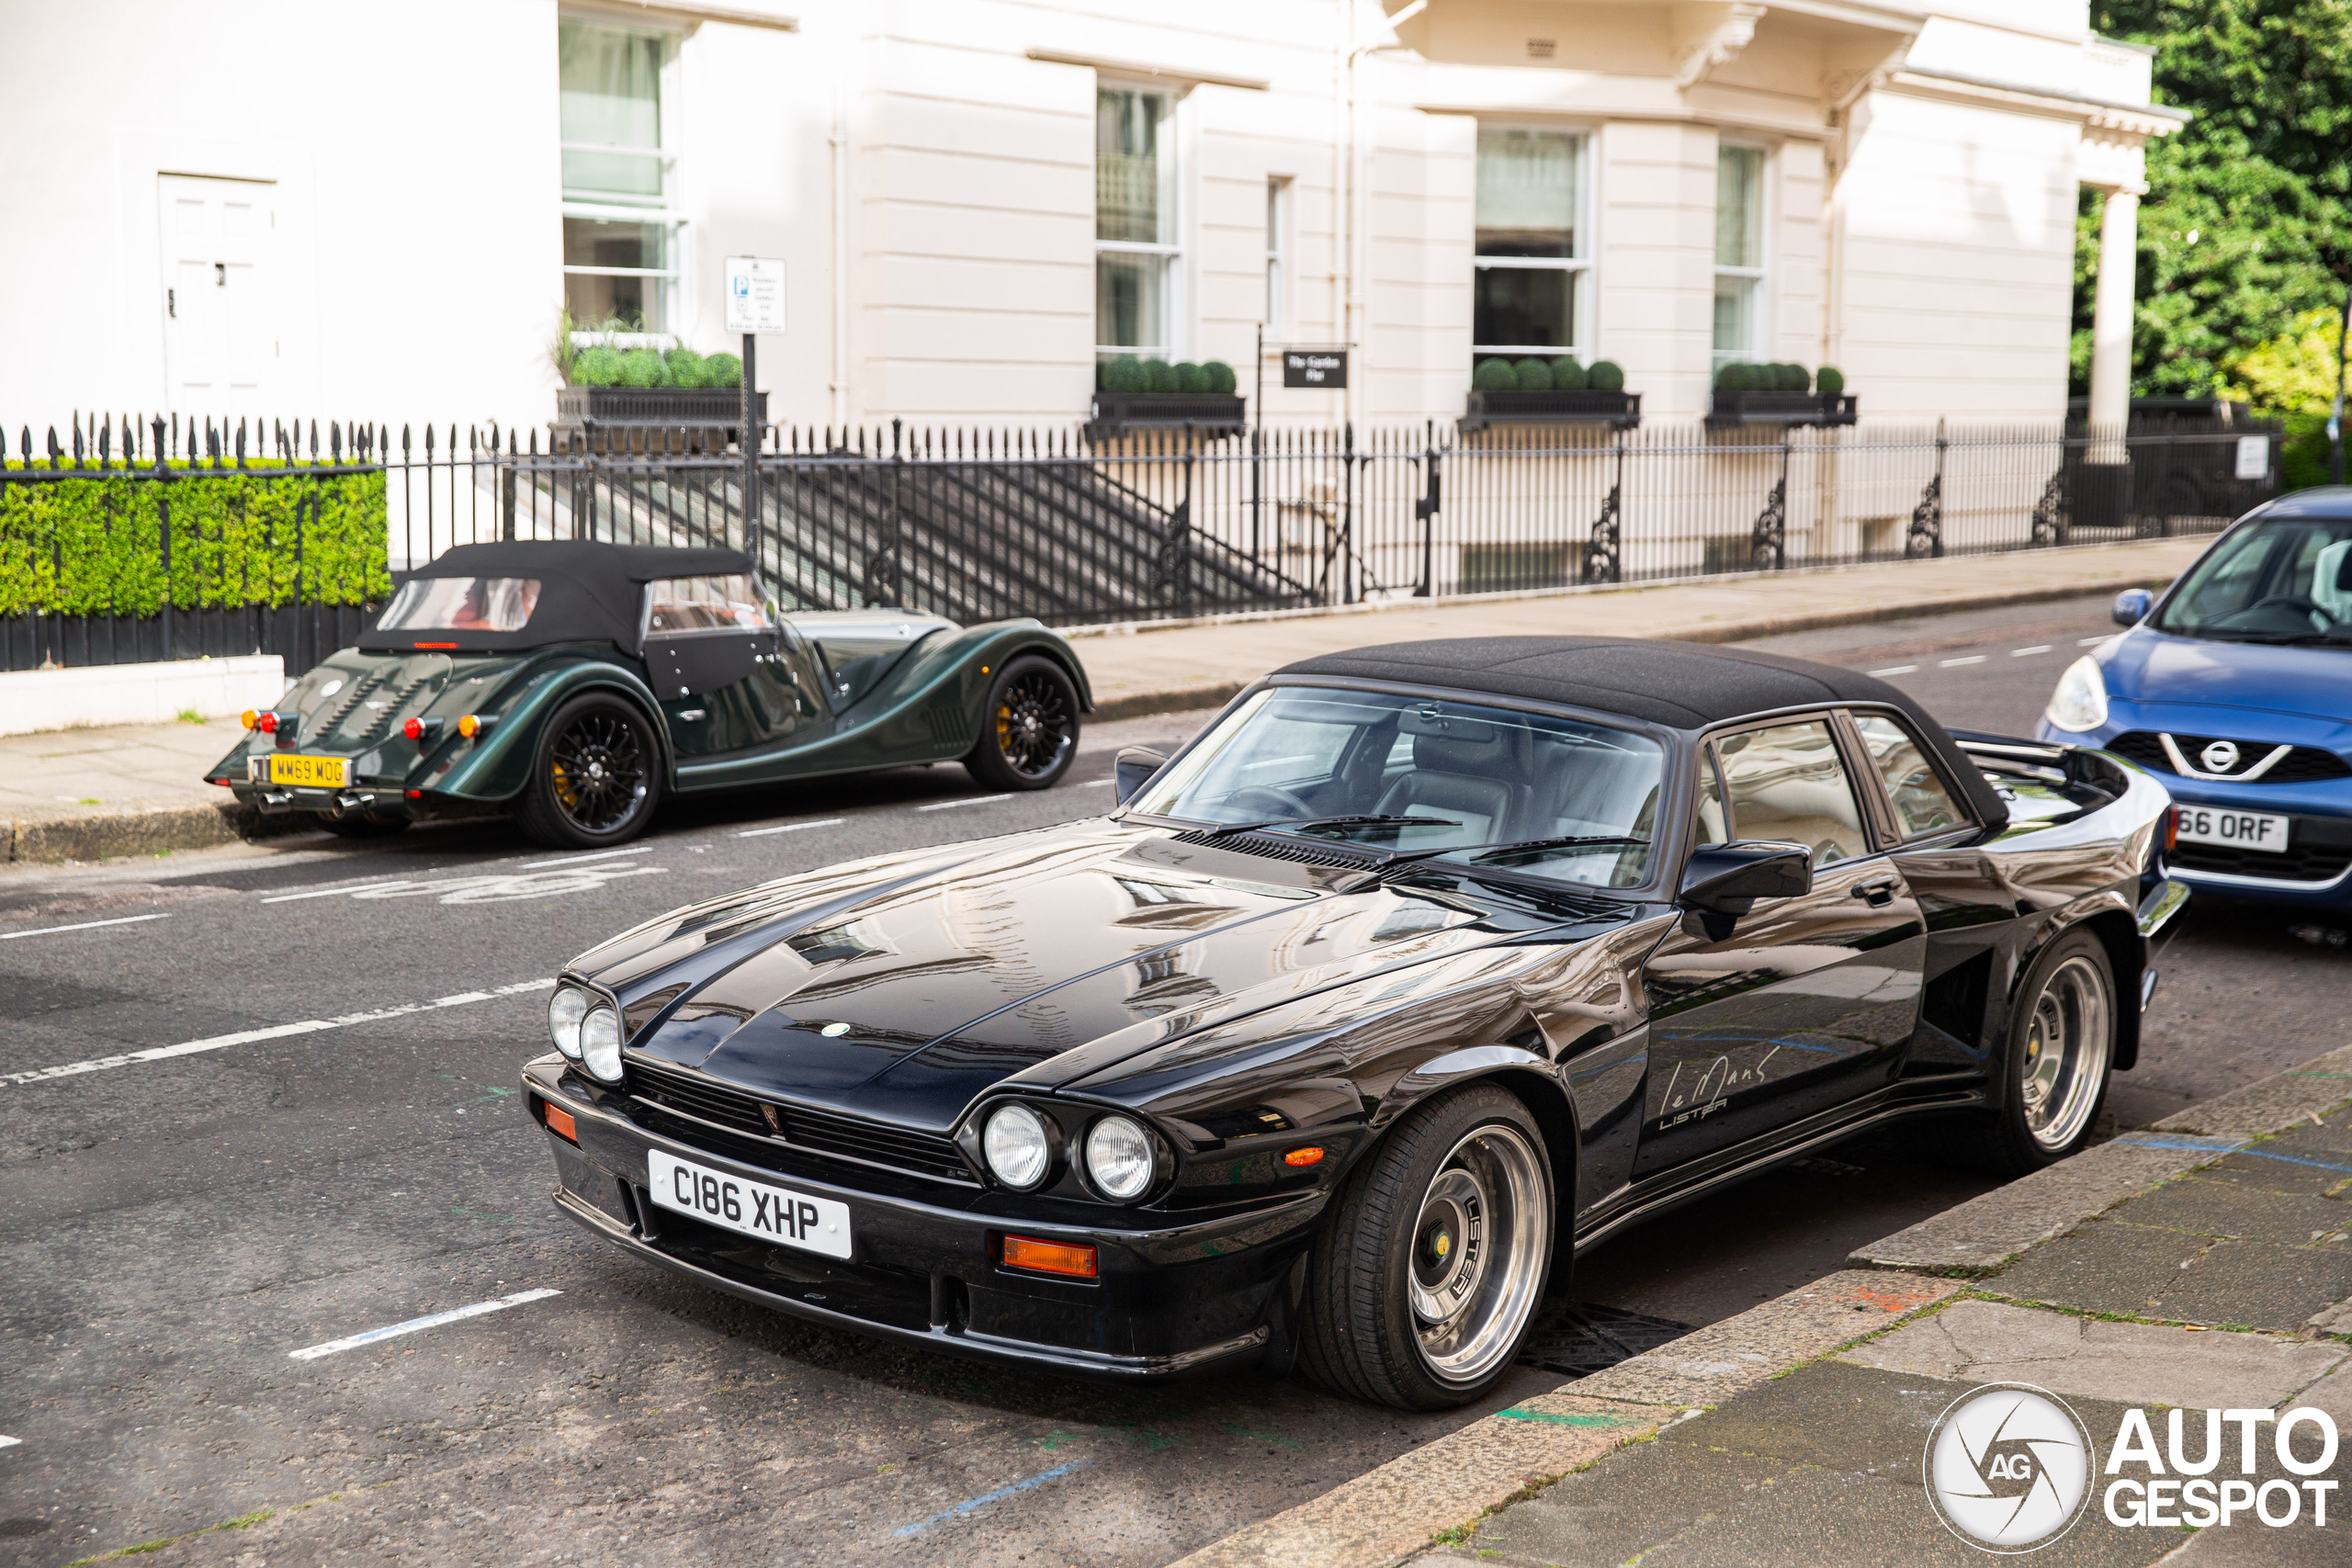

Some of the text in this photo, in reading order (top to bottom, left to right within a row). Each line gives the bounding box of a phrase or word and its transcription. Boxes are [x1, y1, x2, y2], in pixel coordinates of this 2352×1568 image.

[2221, 814, 2276, 841] ORF
[1659, 1098, 1727, 1131] LISTER
[673, 1165, 819, 1241] C186 XHP
[1452, 1199, 1481, 1295] LISTER
